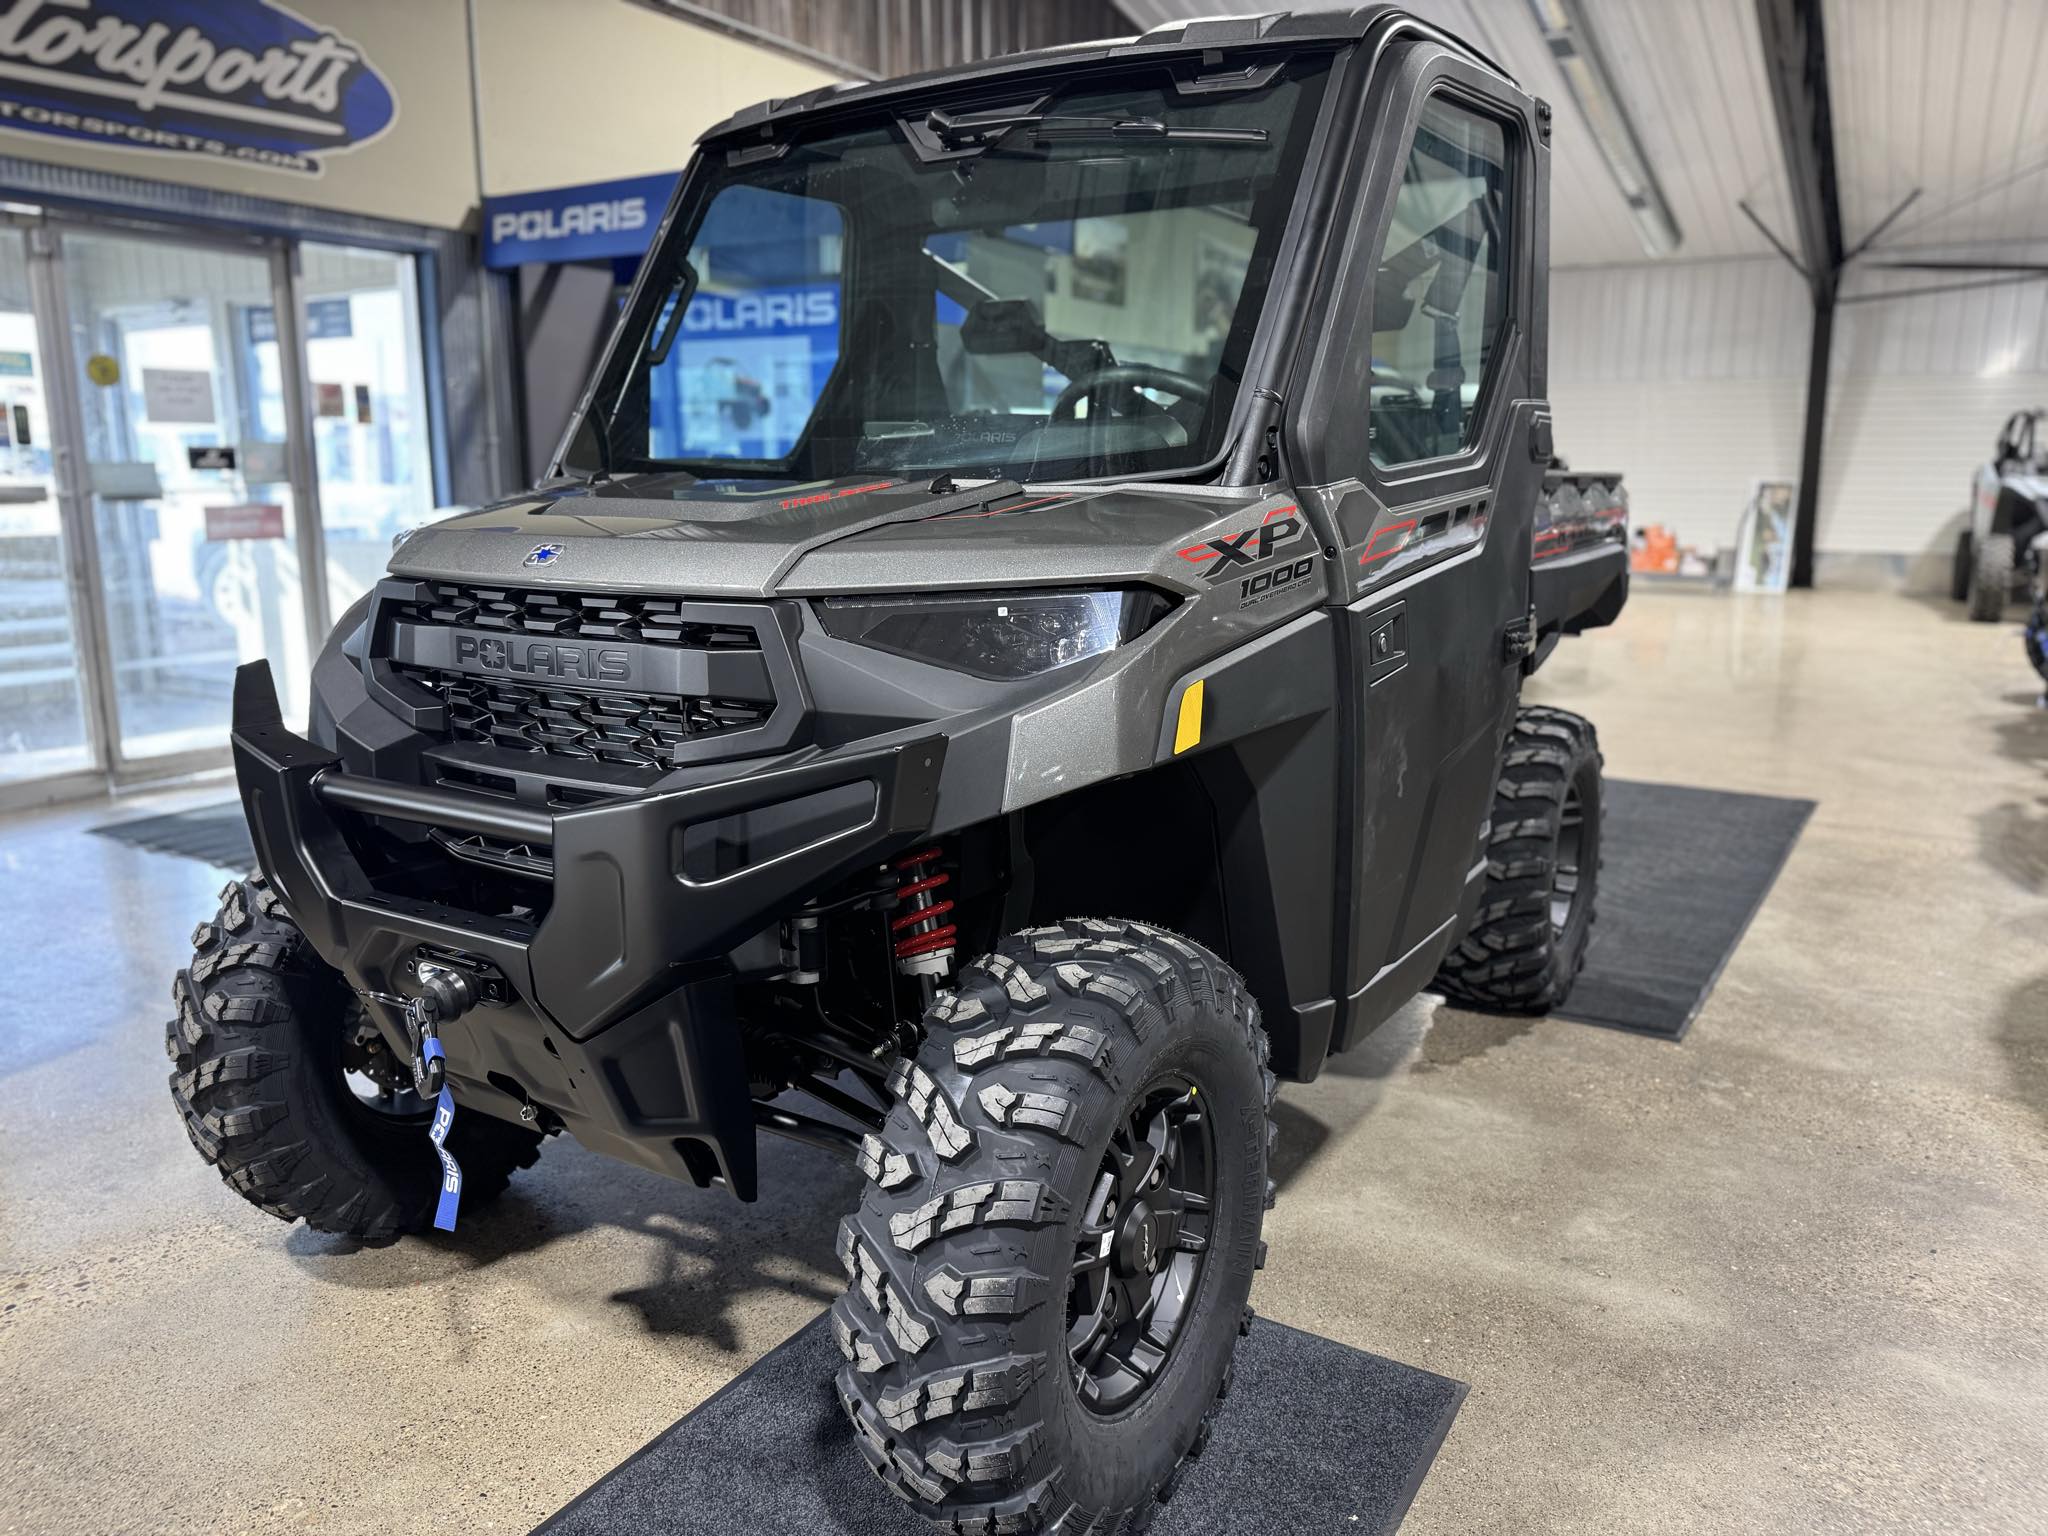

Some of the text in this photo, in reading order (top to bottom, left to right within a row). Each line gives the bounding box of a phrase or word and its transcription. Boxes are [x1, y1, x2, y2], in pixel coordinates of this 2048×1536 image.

[492, 198, 648, 244] POLARIS
[1200, 517, 1301, 579] XP
[1240, 557, 1314, 599] 1000
[455, 635, 632, 684] POLARIS
